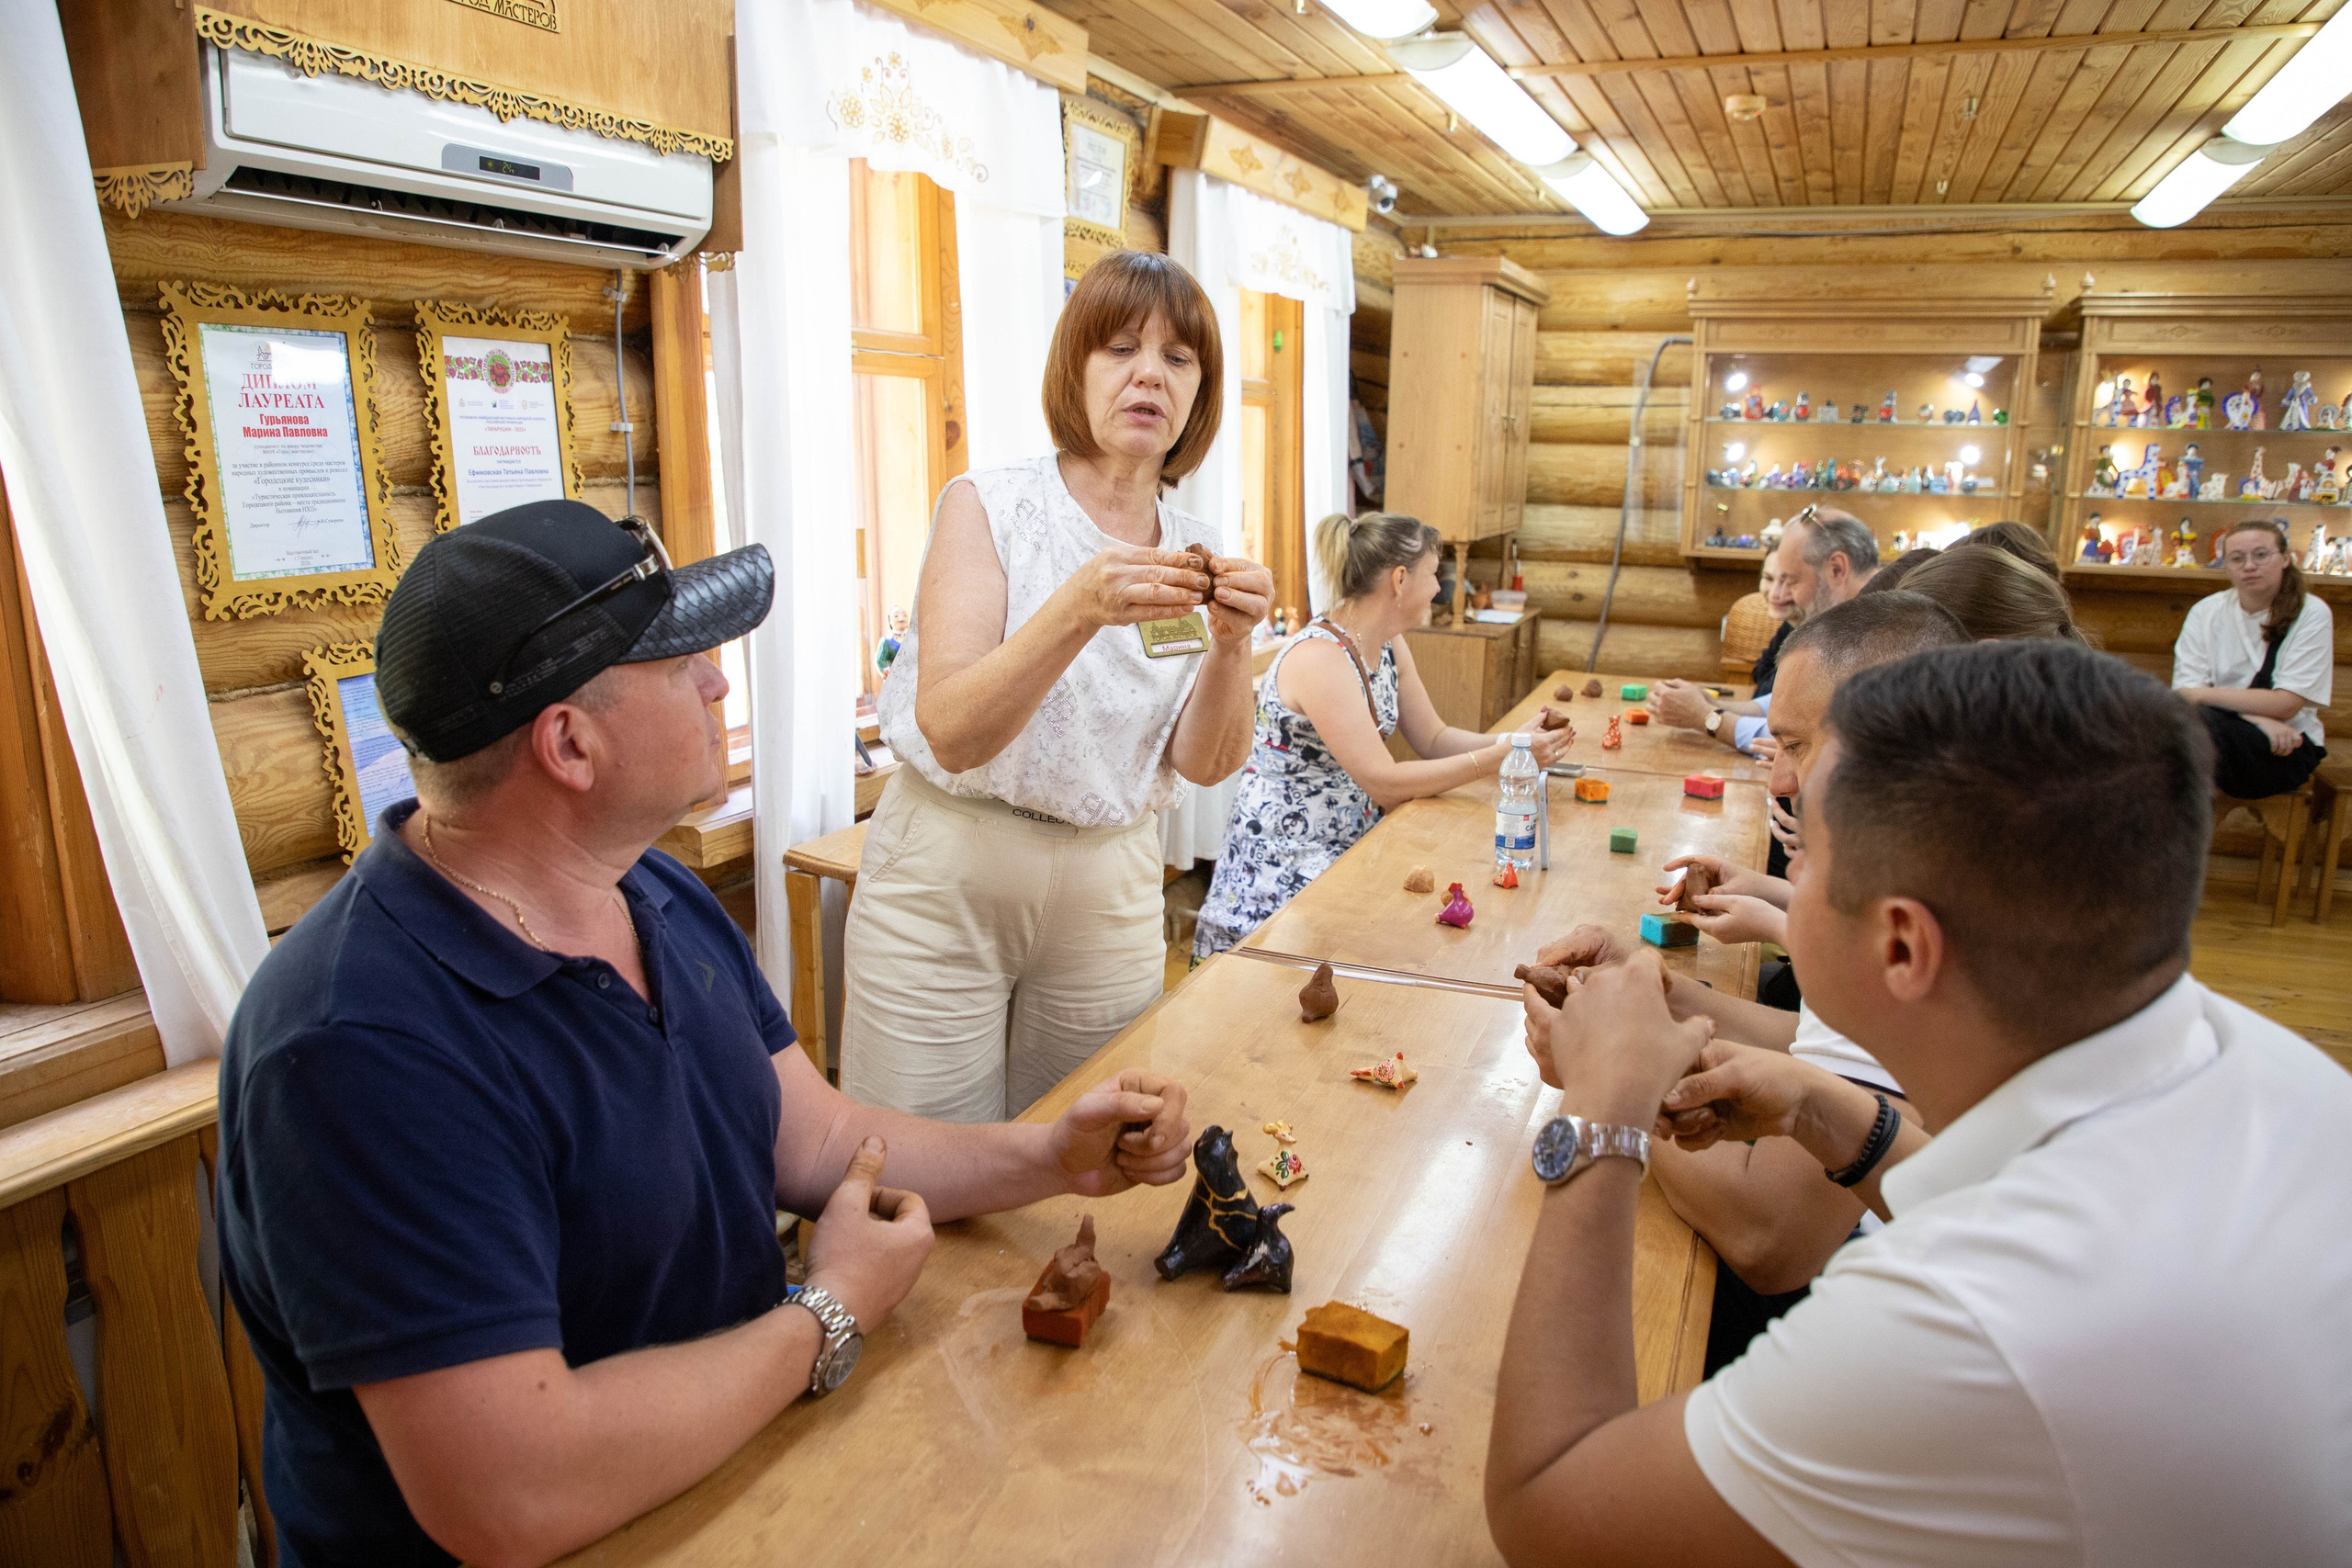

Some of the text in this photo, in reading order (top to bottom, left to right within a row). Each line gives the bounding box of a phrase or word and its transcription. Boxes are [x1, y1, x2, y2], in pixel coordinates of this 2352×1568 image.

[238, 392, 324, 409] ЛАУРЕАТА
[259, 413, 310, 425] Гурьянова
[243, 426, 328, 438] Марина Павловна
[473, 446, 541, 457] БЛАГОДАРНОСТЬ
